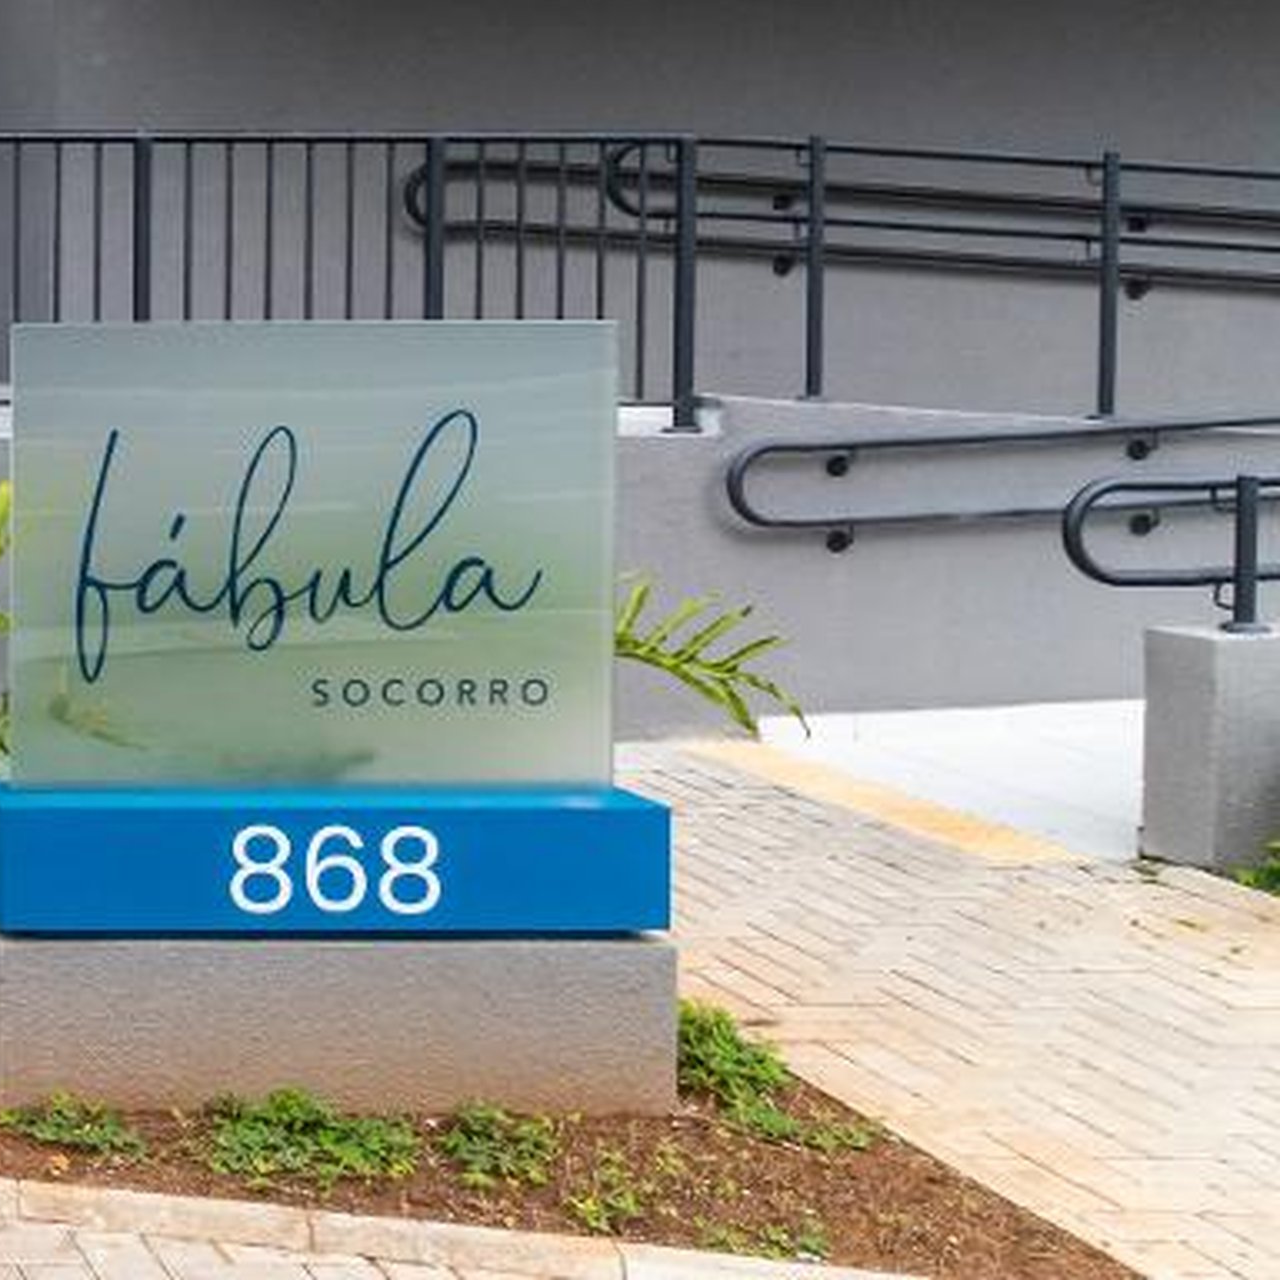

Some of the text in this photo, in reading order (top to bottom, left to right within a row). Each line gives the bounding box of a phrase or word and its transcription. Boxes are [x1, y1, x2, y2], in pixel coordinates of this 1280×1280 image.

[75, 409, 543, 683] fábula
[311, 678, 550, 708] SOCORRO
[229, 824, 441, 915] 868
